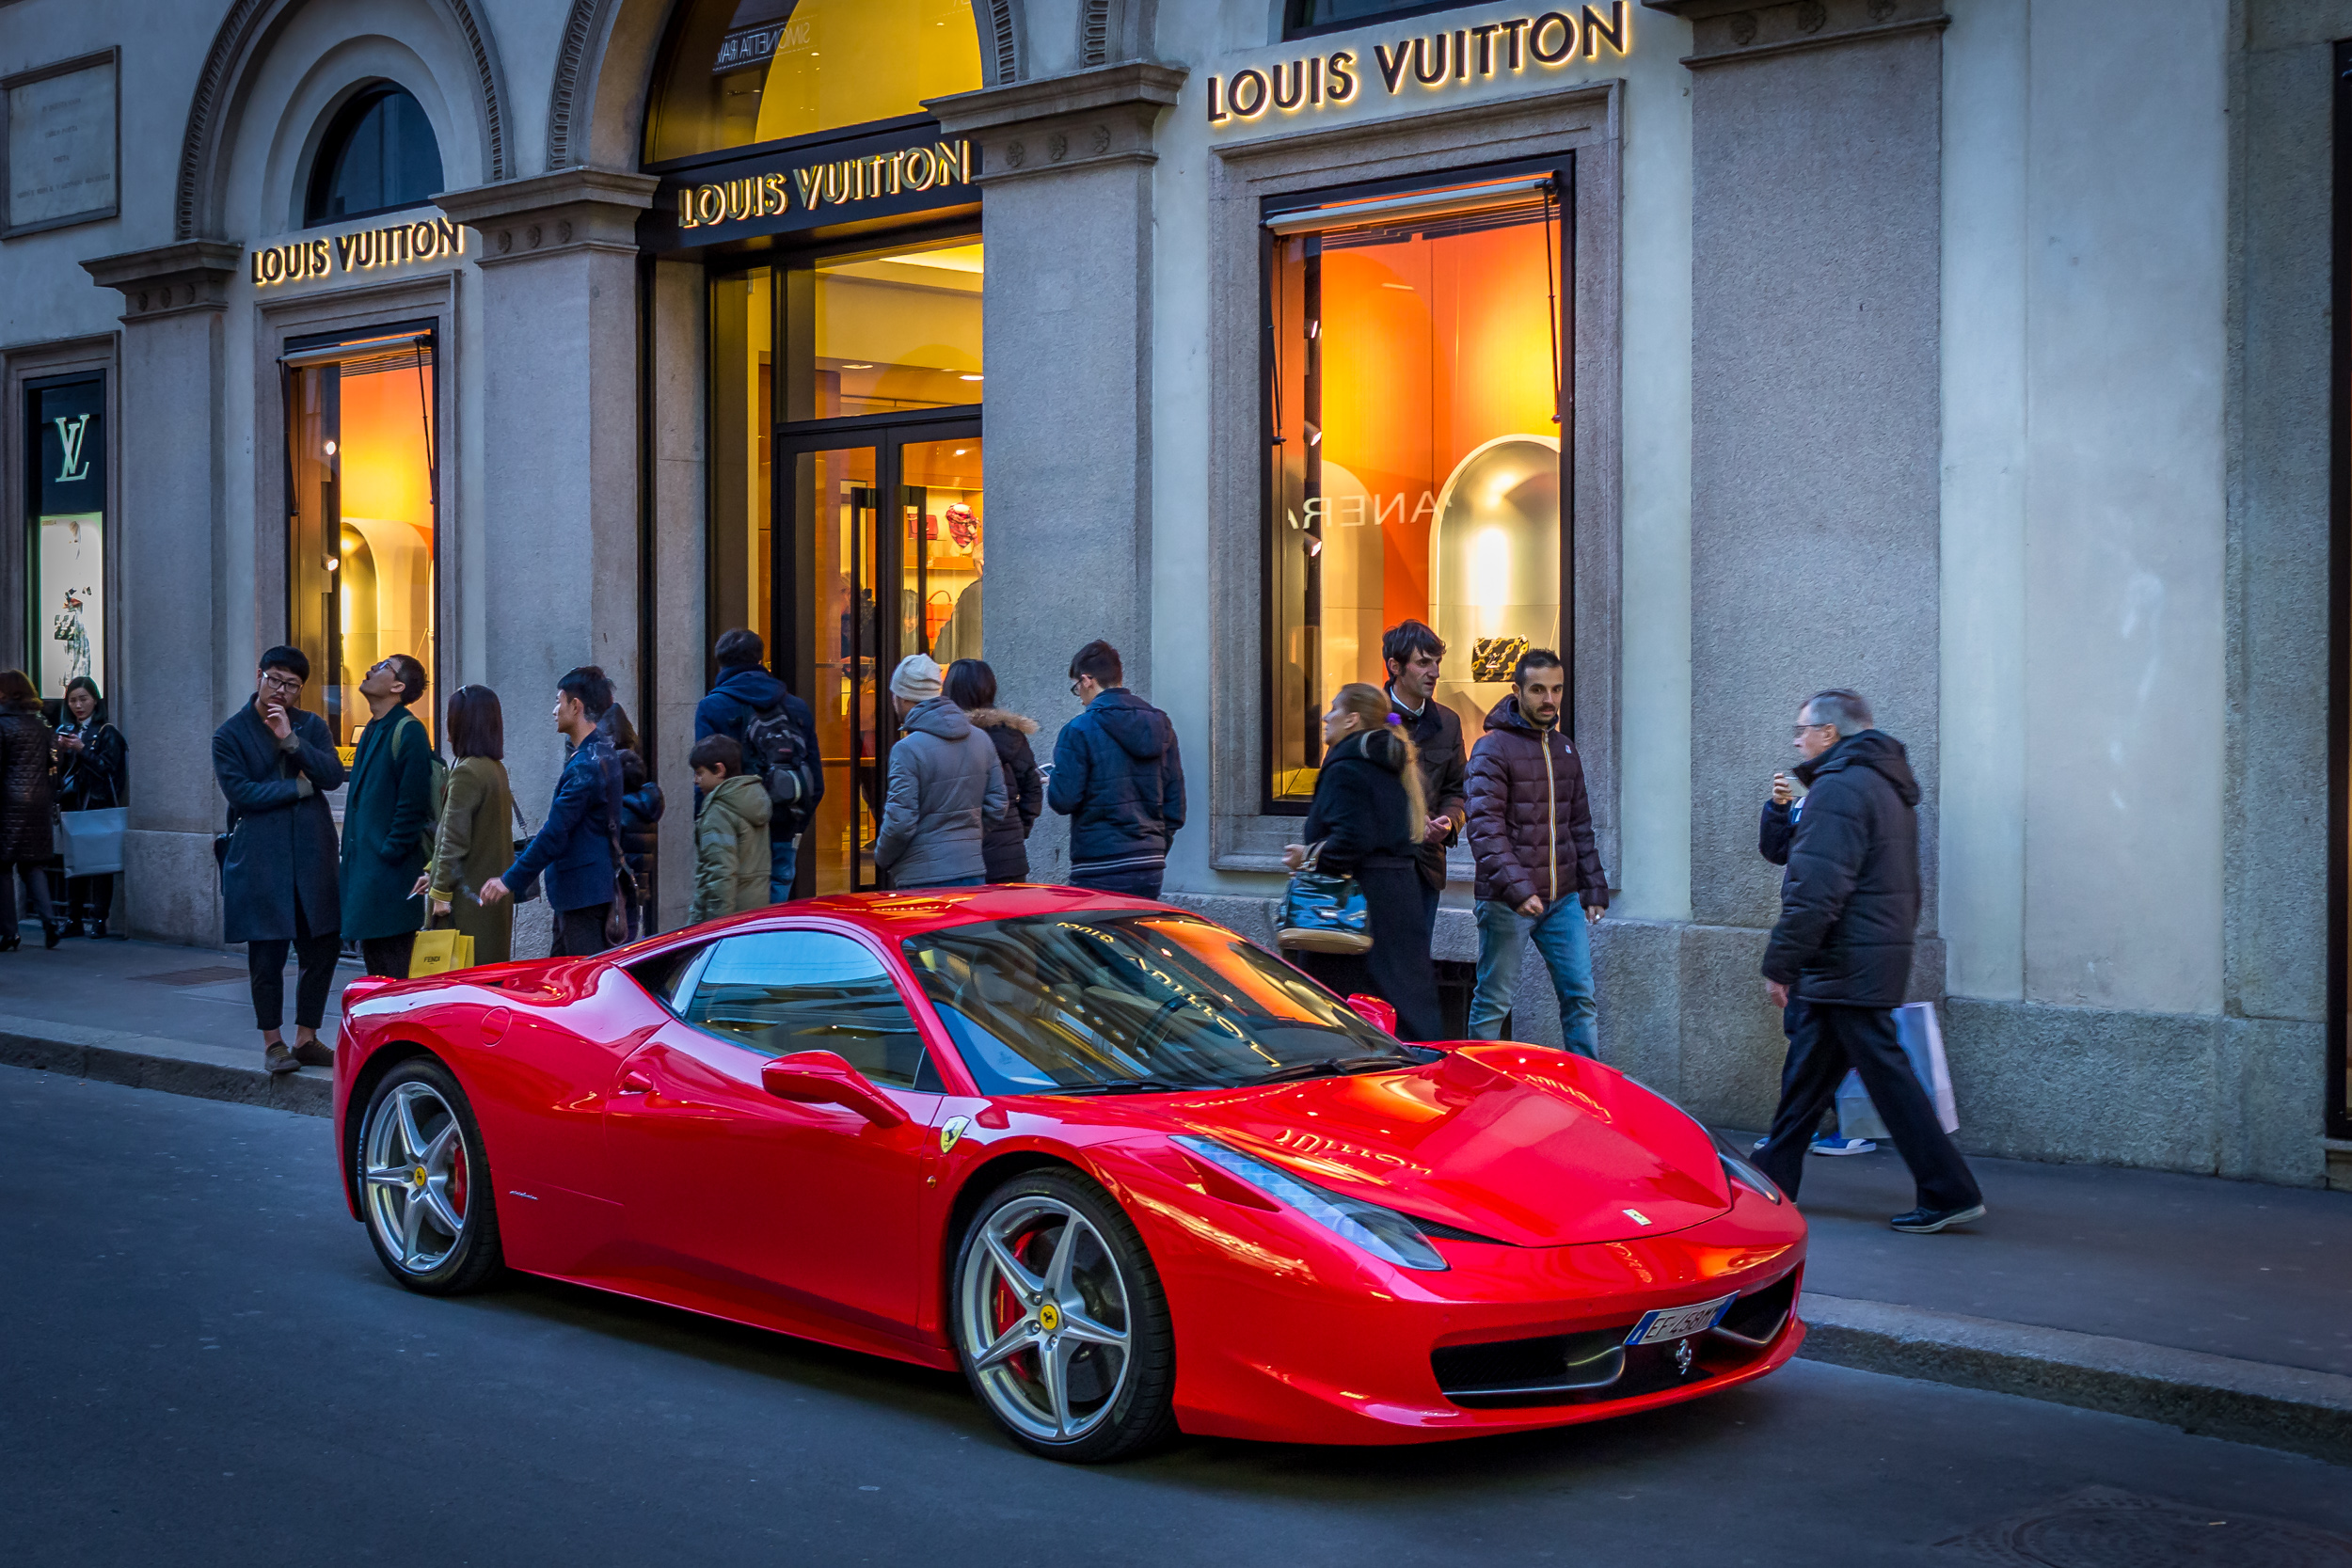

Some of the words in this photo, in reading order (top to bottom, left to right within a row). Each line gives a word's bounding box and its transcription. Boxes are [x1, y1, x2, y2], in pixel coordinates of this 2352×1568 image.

[1208, 52, 1359, 123] LOUIS
[1373, 1, 1627, 95] VUITTON
[678, 173, 788, 229] LOUIS
[793, 140, 970, 211] VUITTON
[251, 239, 331, 286] LOUIS
[335, 216, 464, 273] VUITTON
